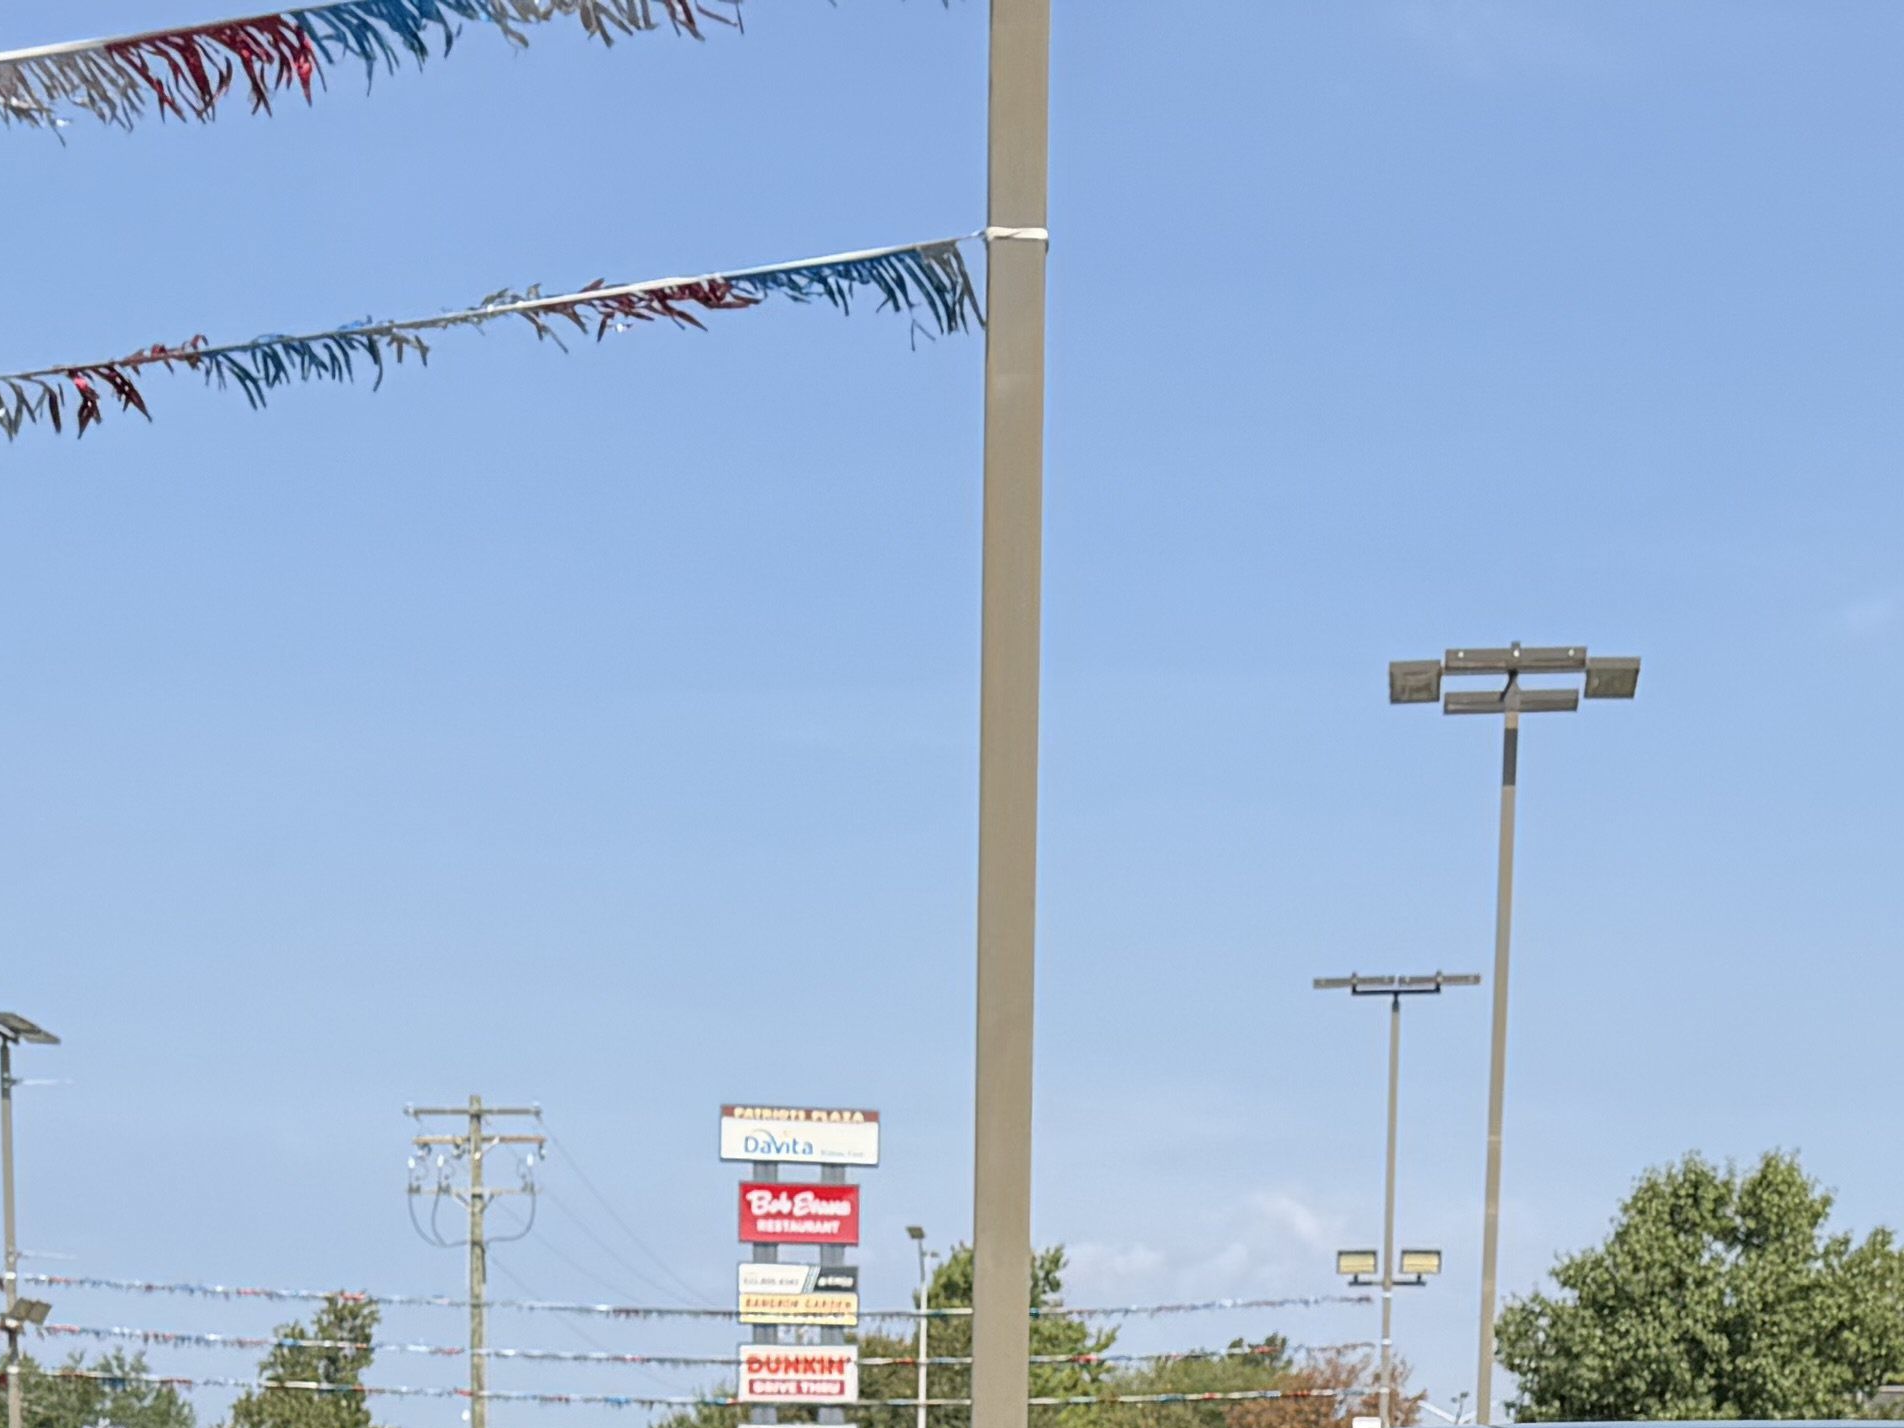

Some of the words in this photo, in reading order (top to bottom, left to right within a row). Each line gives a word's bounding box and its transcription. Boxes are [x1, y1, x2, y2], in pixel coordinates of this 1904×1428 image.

[745, 1189, 793, 1216] Bob
[792, 1190, 852, 1217] Evans
[756, 1218, 840, 1234] RESTAURANT
[746, 1355, 852, 1375] DUNKIN'
